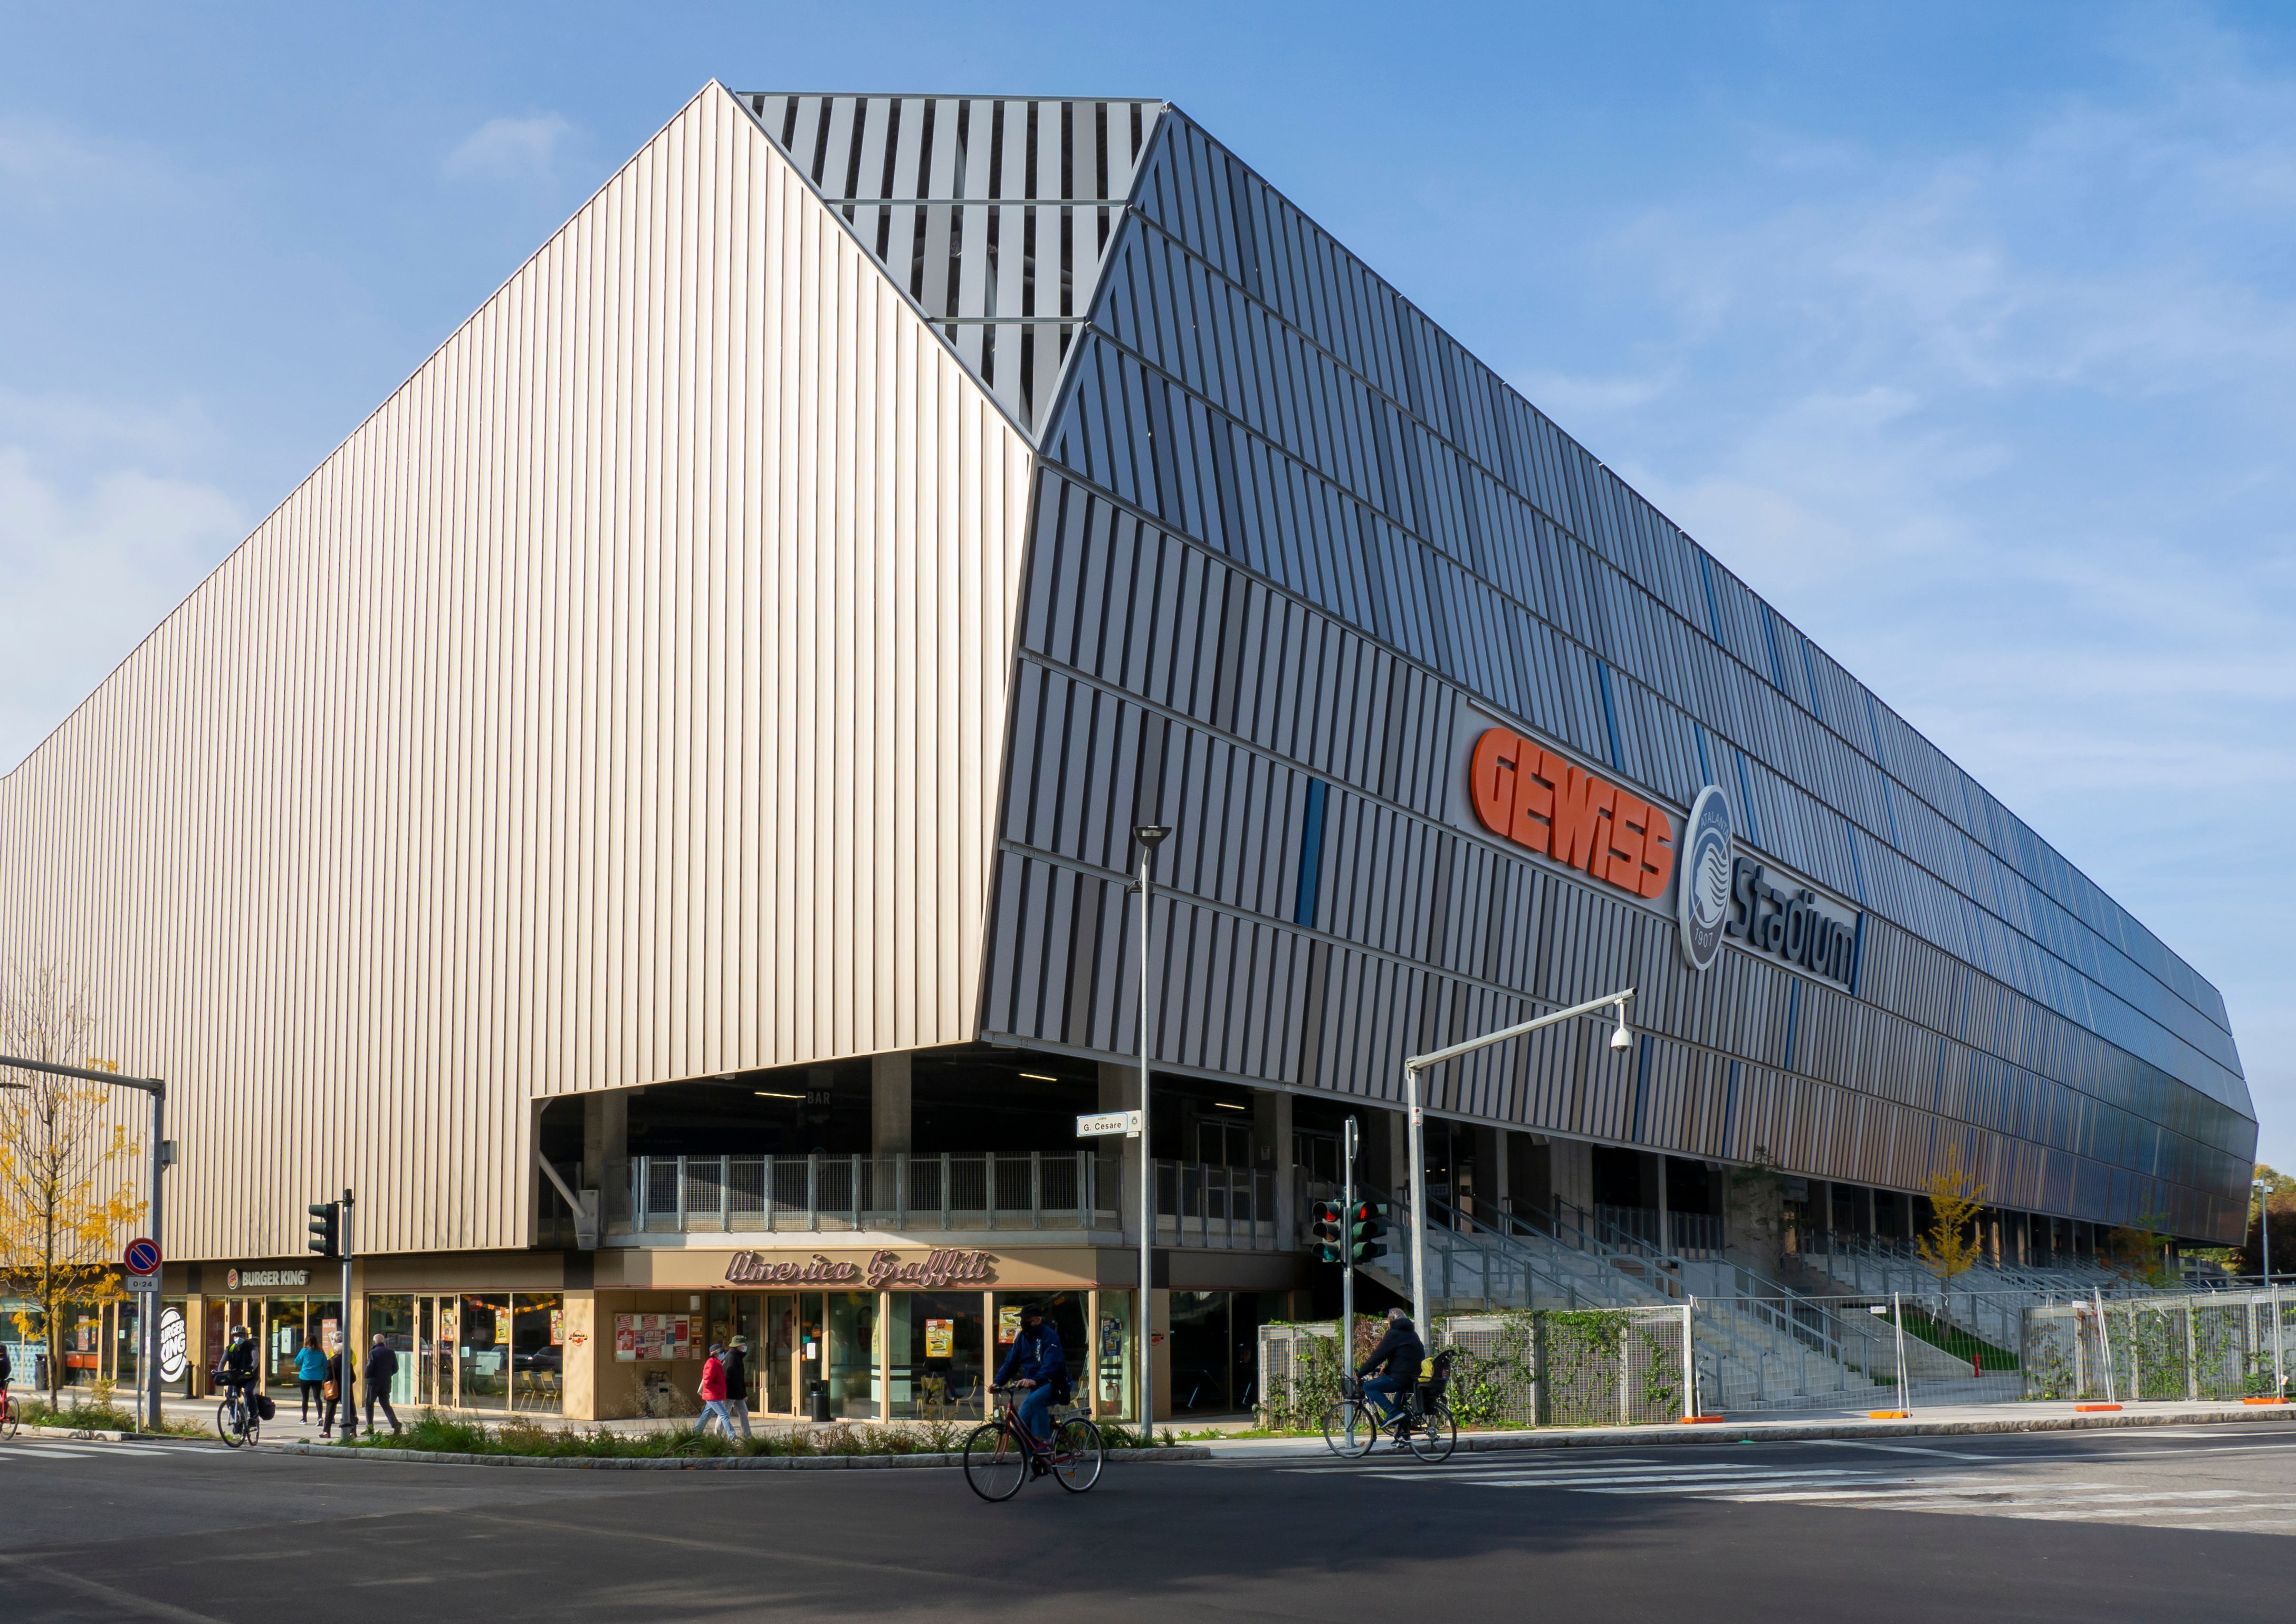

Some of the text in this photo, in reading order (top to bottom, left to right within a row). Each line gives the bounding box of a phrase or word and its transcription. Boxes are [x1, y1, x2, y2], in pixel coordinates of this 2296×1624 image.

[1700, 811, 1729, 842] ATALANTA
[1726, 856, 1855, 986] Stadium
[1694, 928, 1714, 949] 1907
[807, 1091, 830, 1105] BAR
[242, 1270, 280, 1286] BURGER
[280, 1269, 306, 1286] KING
[725, 1248, 990, 1287] America Graffiti
